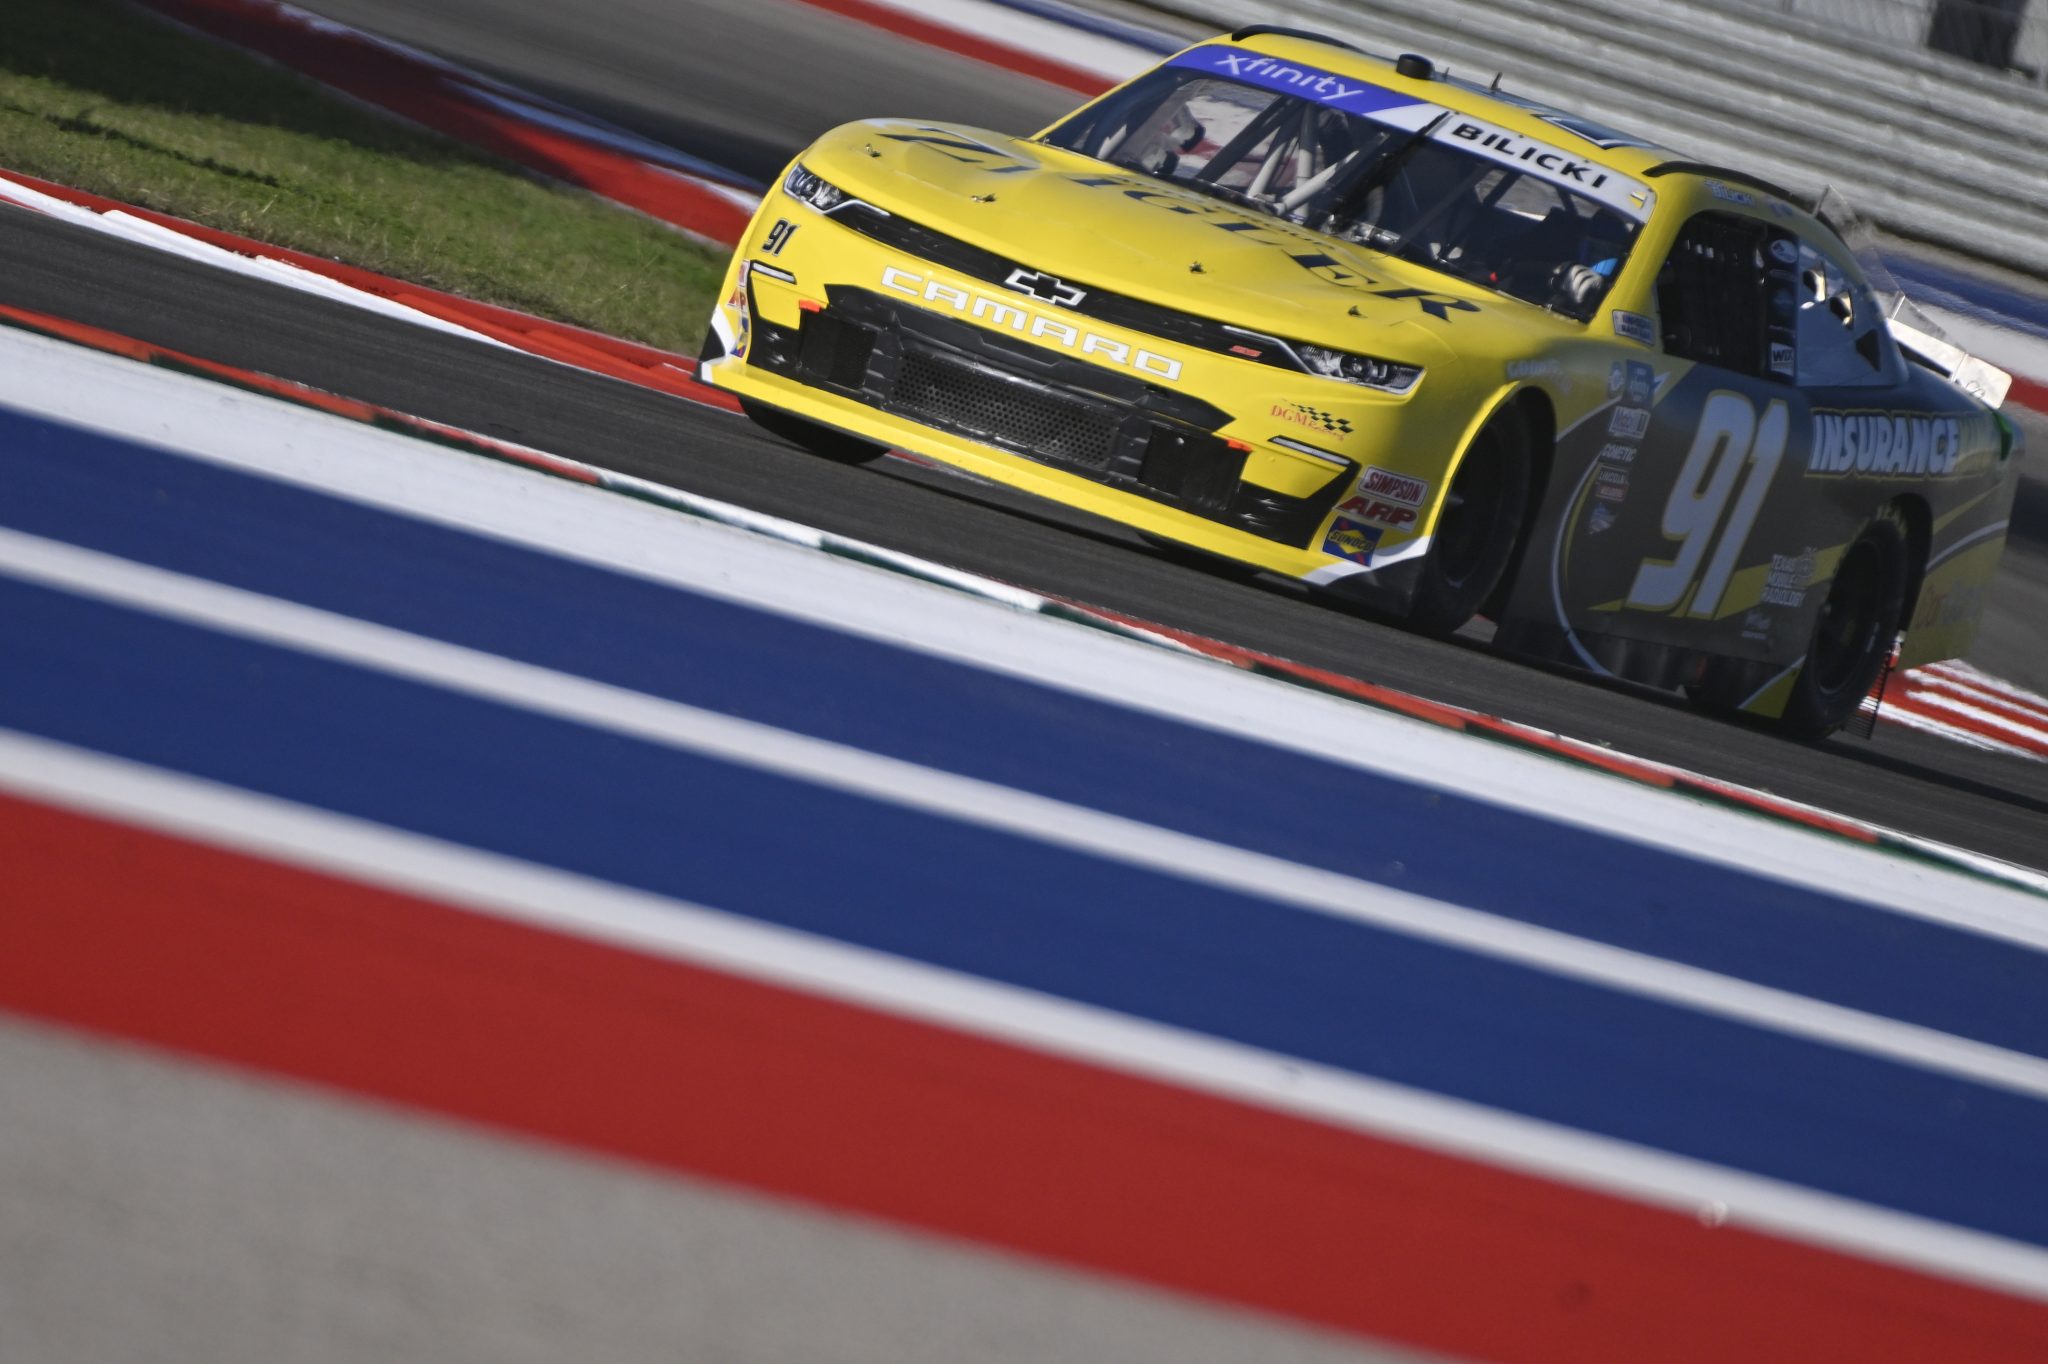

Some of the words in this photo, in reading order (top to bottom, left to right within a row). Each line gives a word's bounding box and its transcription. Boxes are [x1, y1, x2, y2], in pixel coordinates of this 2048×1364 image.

[1215, 53, 1365, 101] xfinity
[1451, 122, 1609, 189] BILICKI
[760, 218, 801, 257] 91
[880, 265, 1184, 382] CAMARO
[1270, 404, 1308, 427] DGM
[1806, 413, 1961, 475] INSURANCE
[1364, 471, 1425, 503] SIMPSON
[1624, 389, 1790, 620] 91
[1334, 495, 1419, 526] ARP
[1329, 531, 1376, 551] SUNOCO
